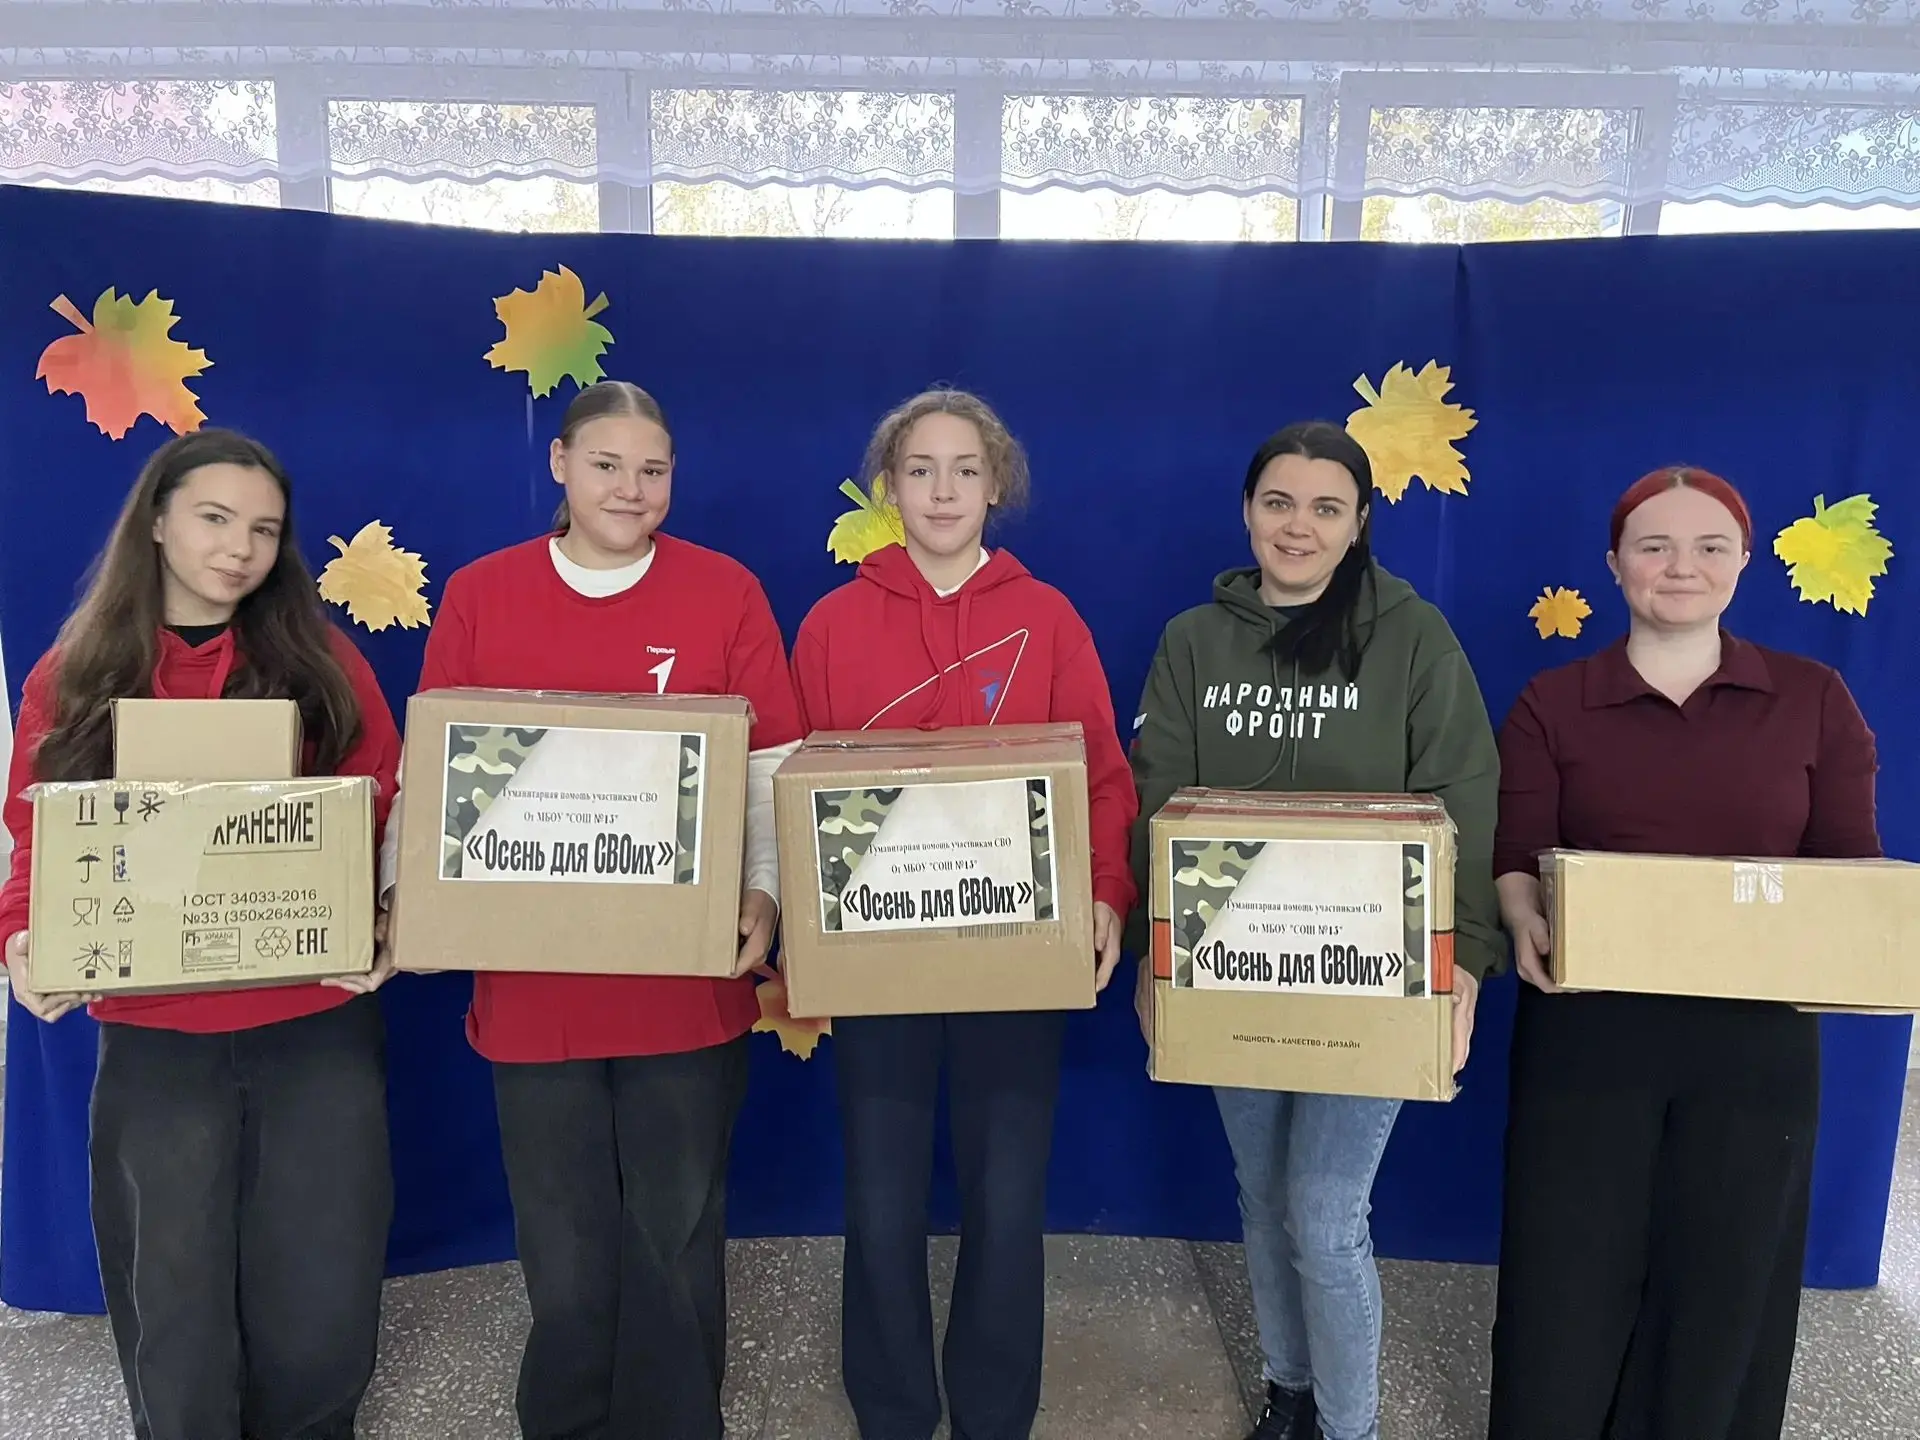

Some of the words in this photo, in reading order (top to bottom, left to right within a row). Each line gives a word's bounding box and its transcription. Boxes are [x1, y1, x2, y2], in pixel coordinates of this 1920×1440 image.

[1203, 682, 1359, 711] НАРОДНЫЙ
[1226, 709, 1326, 739] ФРОНТ
[502, 787, 558, 802] Гуманитарная
[560, 791, 590, 801] помощь
[592, 793, 638, 803] участникам
[639, 792, 658, 802] СВО
[523, 811, 534, 822] От
[537, 812, 563, 823] МБОУ
[466, 829, 545, 872] «Осень
[550, 842, 588, 876] для
[594, 832, 674, 875] СВОих»
[868, 842, 921, 856] Гуманитарная
[922, 841, 950, 851] помощь
[951, 840, 993, 852] участникам
[994, 837, 1012, 848] СВО
[891, 864, 901, 875] От
[903, 862, 926, 873] МБОУ
[231, 888, 317, 905] 34033-2016
[843, 884, 916, 922] «Осень
[920, 889, 954, 922] для
[958, 876, 1033, 917] СВОих»
[183, 911, 219, 925] №33
[224, 904, 333, 926] (350x264x232)
[1226, 899, 1281, 913] Гуманитарная
[1283, 903, 1314, 913] помощь
[1315, 904, 1361, 915] участникам
[1363, 902, 1382, 913] СВО
[1248, 923, 1259, 934] От
[1262, 923, 1287, 935] МБОУ
[1196, 940, 1273, 982] «Осень
[1278, 953, 1315, 986] для
[1321, 944, 1403, 986] СВОих»
[1232, 1034, 1276, 1044] МОЩНОСТЬ
[1281, 1037, 1321, 1047] КАЧЕСТВО
[1327, 1039, 1360, 1049] ДИЗАЙН
